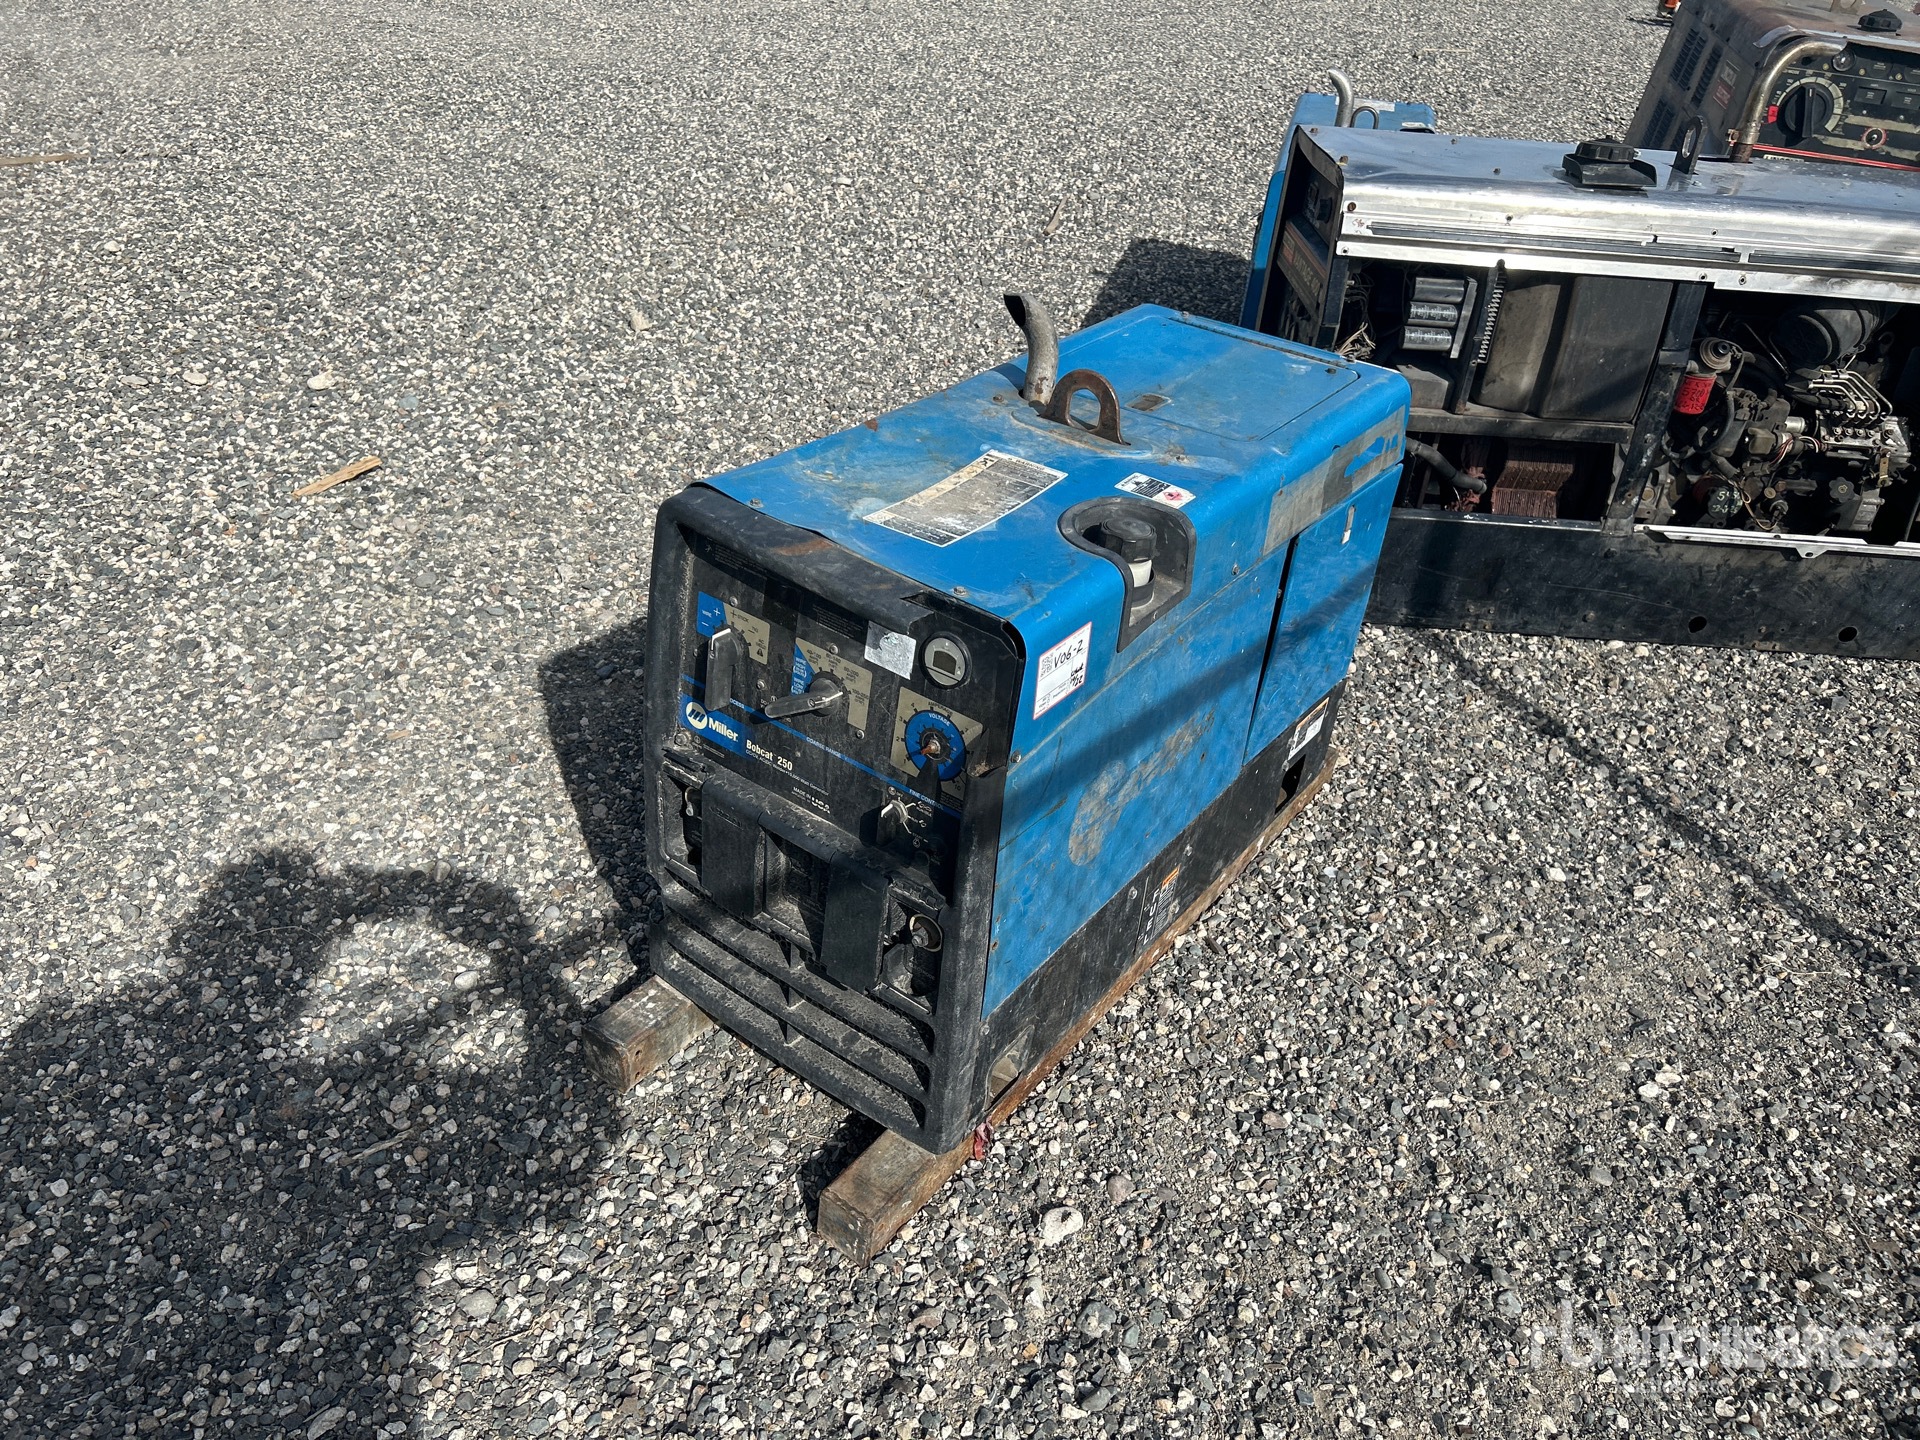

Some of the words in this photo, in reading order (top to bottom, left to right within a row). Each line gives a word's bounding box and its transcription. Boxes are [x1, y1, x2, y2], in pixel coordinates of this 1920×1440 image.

[928, 713, 951, 727] VOLTAGE
[708, 717, 739, 742] Miller
[746, 739, 774, 761] Bobcat
[777, 756, 793, 771] 250
[793, 786, 806, 796] MADE
[909, 788, 921, 799] FINE
